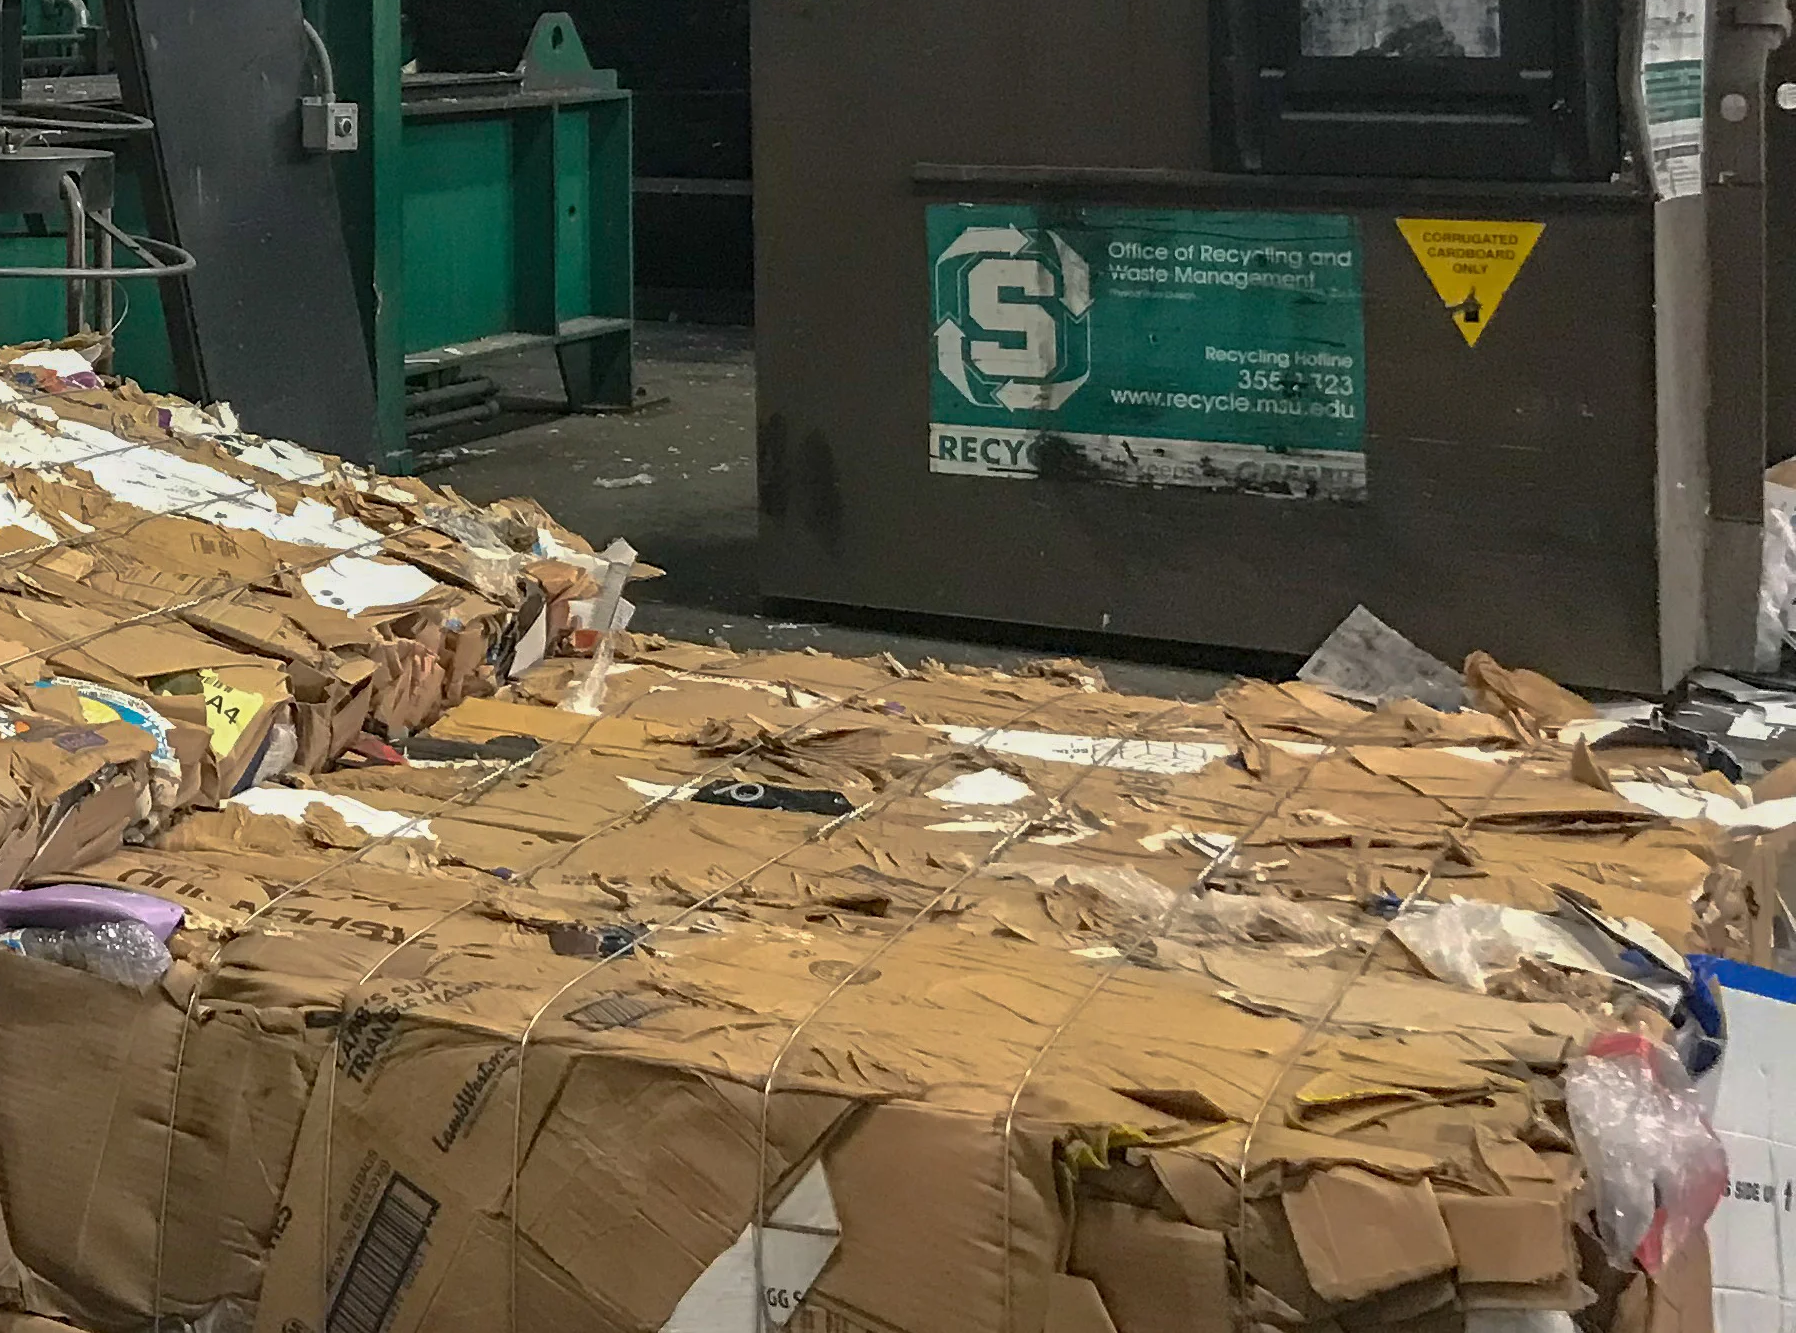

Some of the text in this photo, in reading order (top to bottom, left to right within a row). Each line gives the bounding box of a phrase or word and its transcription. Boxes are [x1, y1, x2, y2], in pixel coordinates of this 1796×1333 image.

[1422, 232, 1518, 246] CORRUGATED
[1108, 241, 1169, 261] Office
[1174, 244, 1195, 262] of
[1308, 250, 1353, 267] and
[1427, 246, 1516, 261] CARDBOARD
[1109, 263, 1316, 290] Waste Management
[1452, 263, 1489, 275] ONLY
[1205, 346, 1354, 369] Recycling Hotline
[1110, 389, 1355, 419] www.recycle.msu.edu
[205, 695, 241, 725] A4
